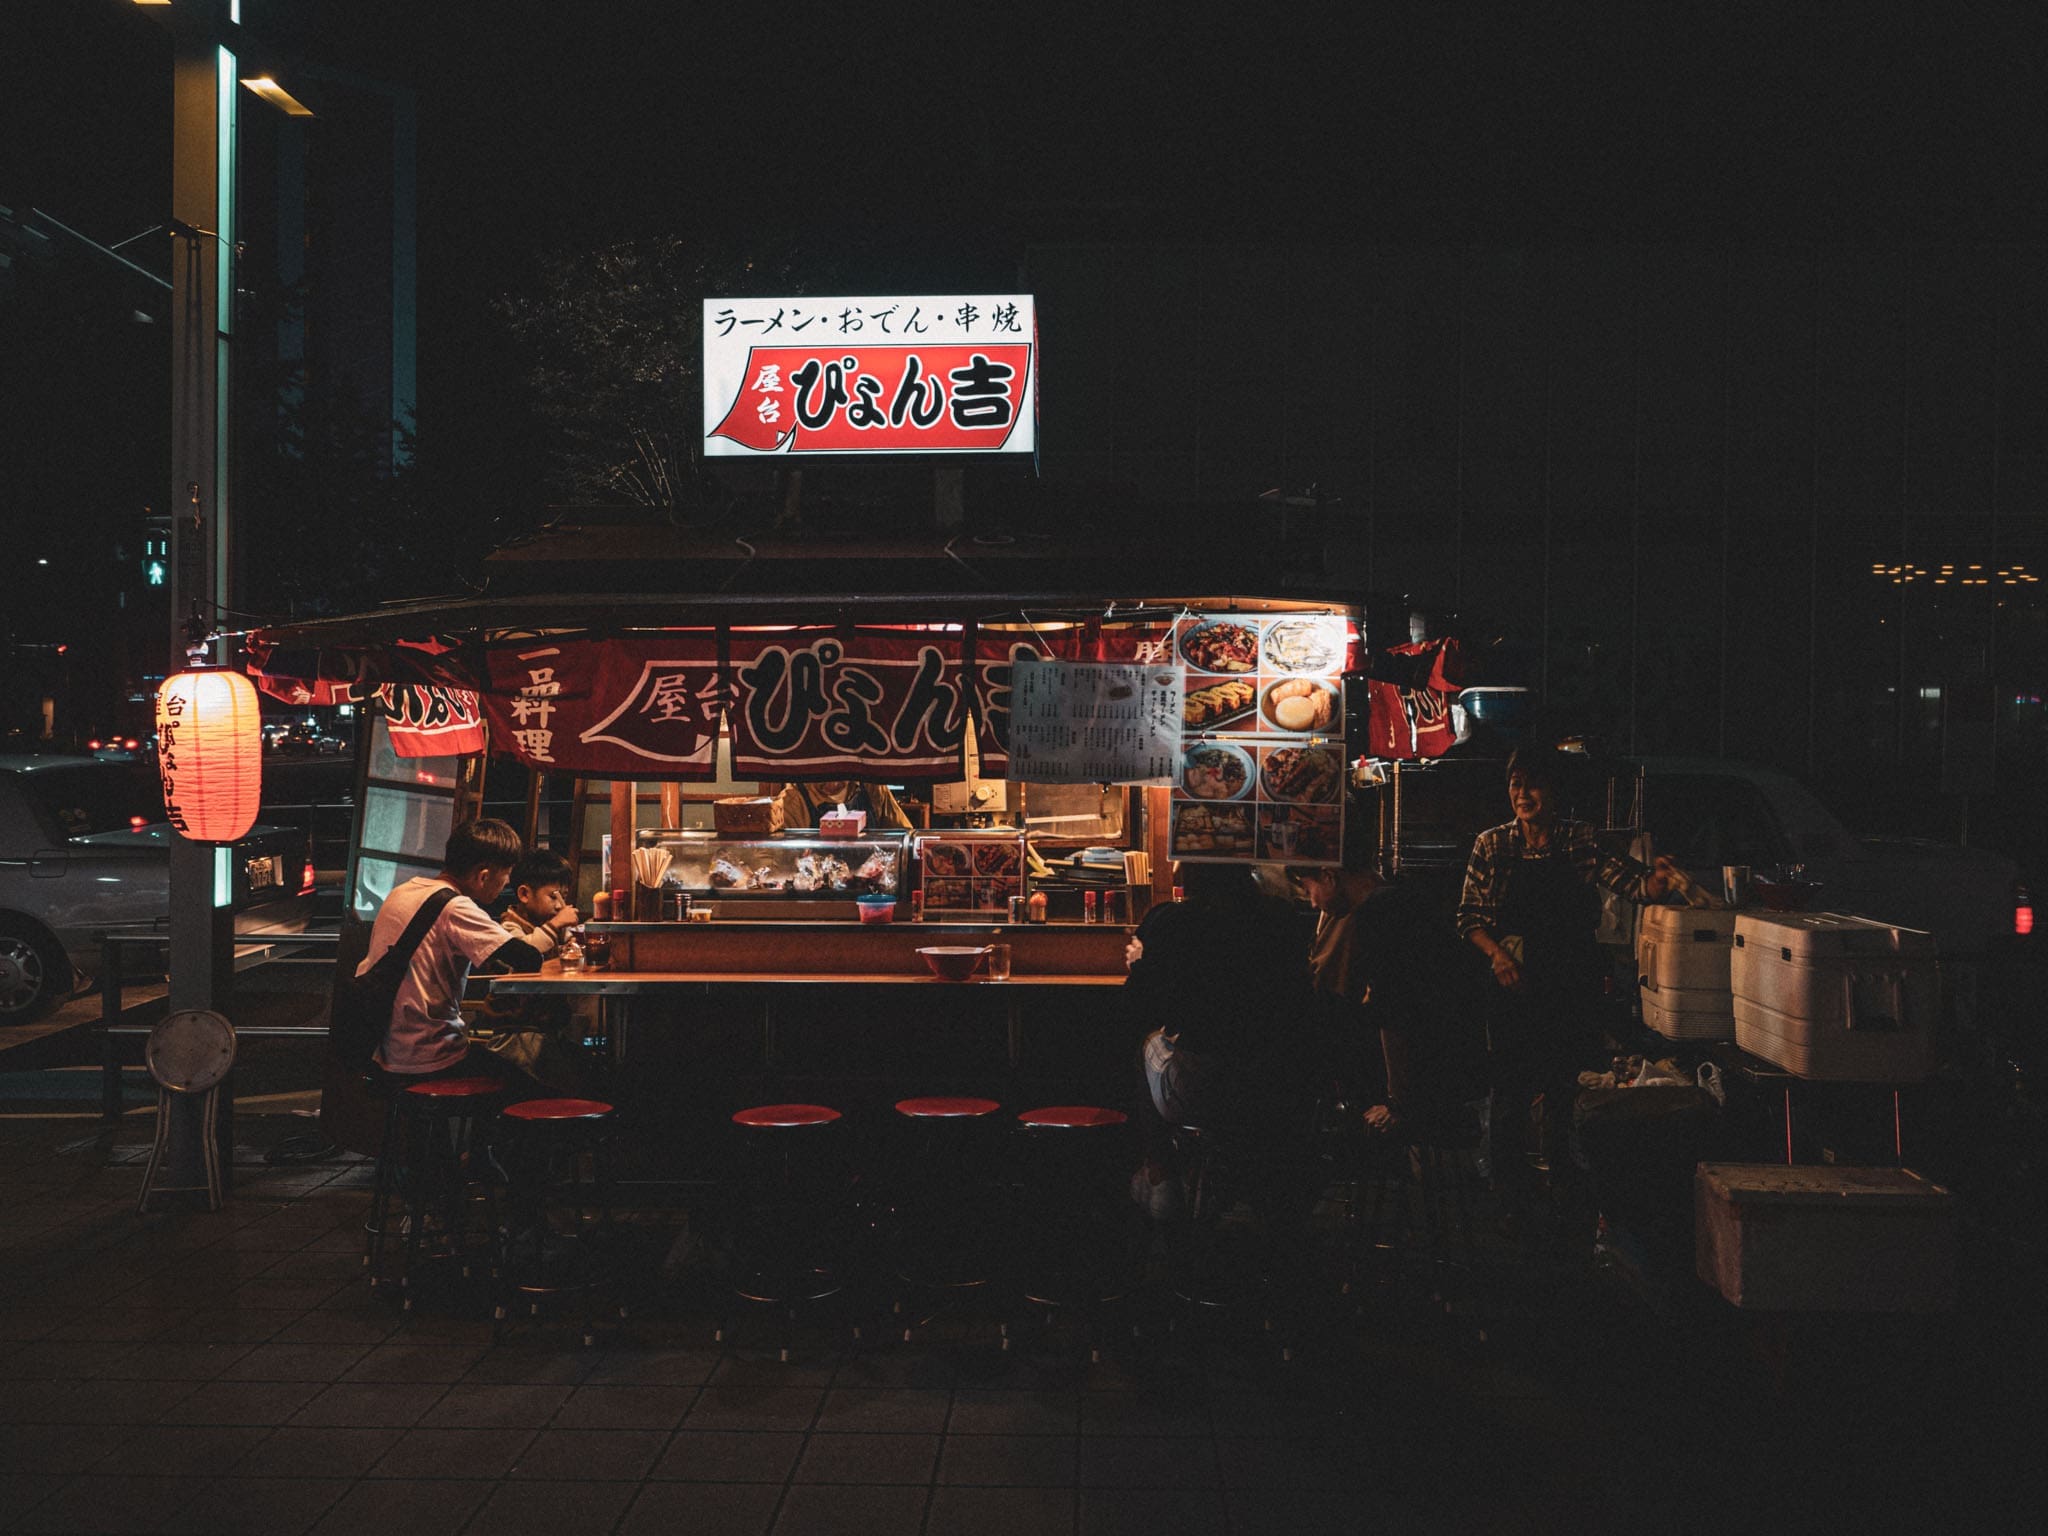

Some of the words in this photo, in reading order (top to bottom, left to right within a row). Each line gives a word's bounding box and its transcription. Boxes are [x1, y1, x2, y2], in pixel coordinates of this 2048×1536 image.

[751, 364, 784, 424] 屋台
[789, 355, 1014, 429] ぴょん吉
[510, 647, 560, 763] 一品料理
[639, 673, 740, 723] 屋台
